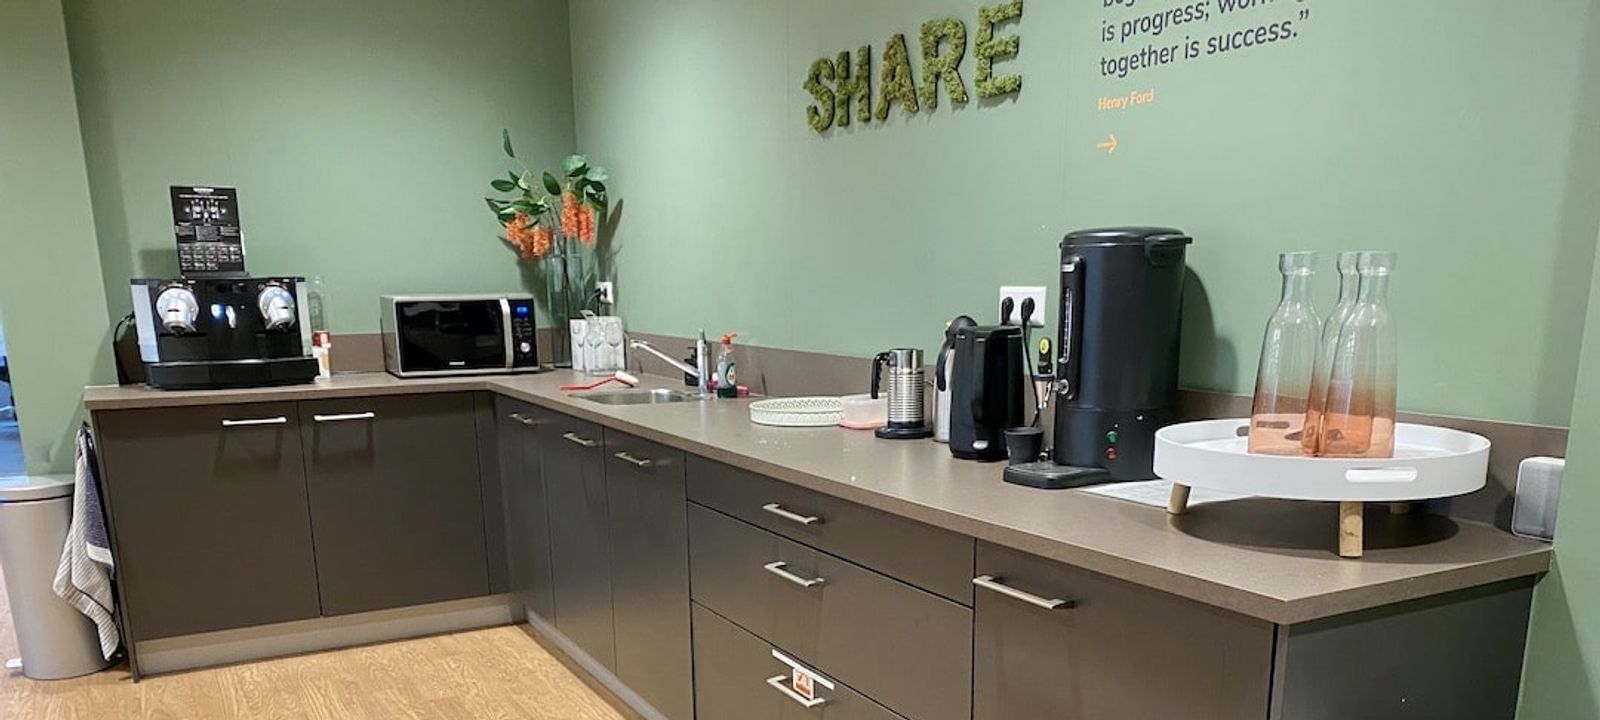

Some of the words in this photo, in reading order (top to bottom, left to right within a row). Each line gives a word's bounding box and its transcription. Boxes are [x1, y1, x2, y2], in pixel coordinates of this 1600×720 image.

[1102, 20, 1115, 42] is
[1121, 1, 1210, 43] progress;
[803, 0, 1023, 132] SHARE
[1100, 43, 1178, 78] together
[1184, 36, 1200, 59] is
[1098, 96, 1129, 110] Henry
[1130, 88, 1155, 106] Ford
